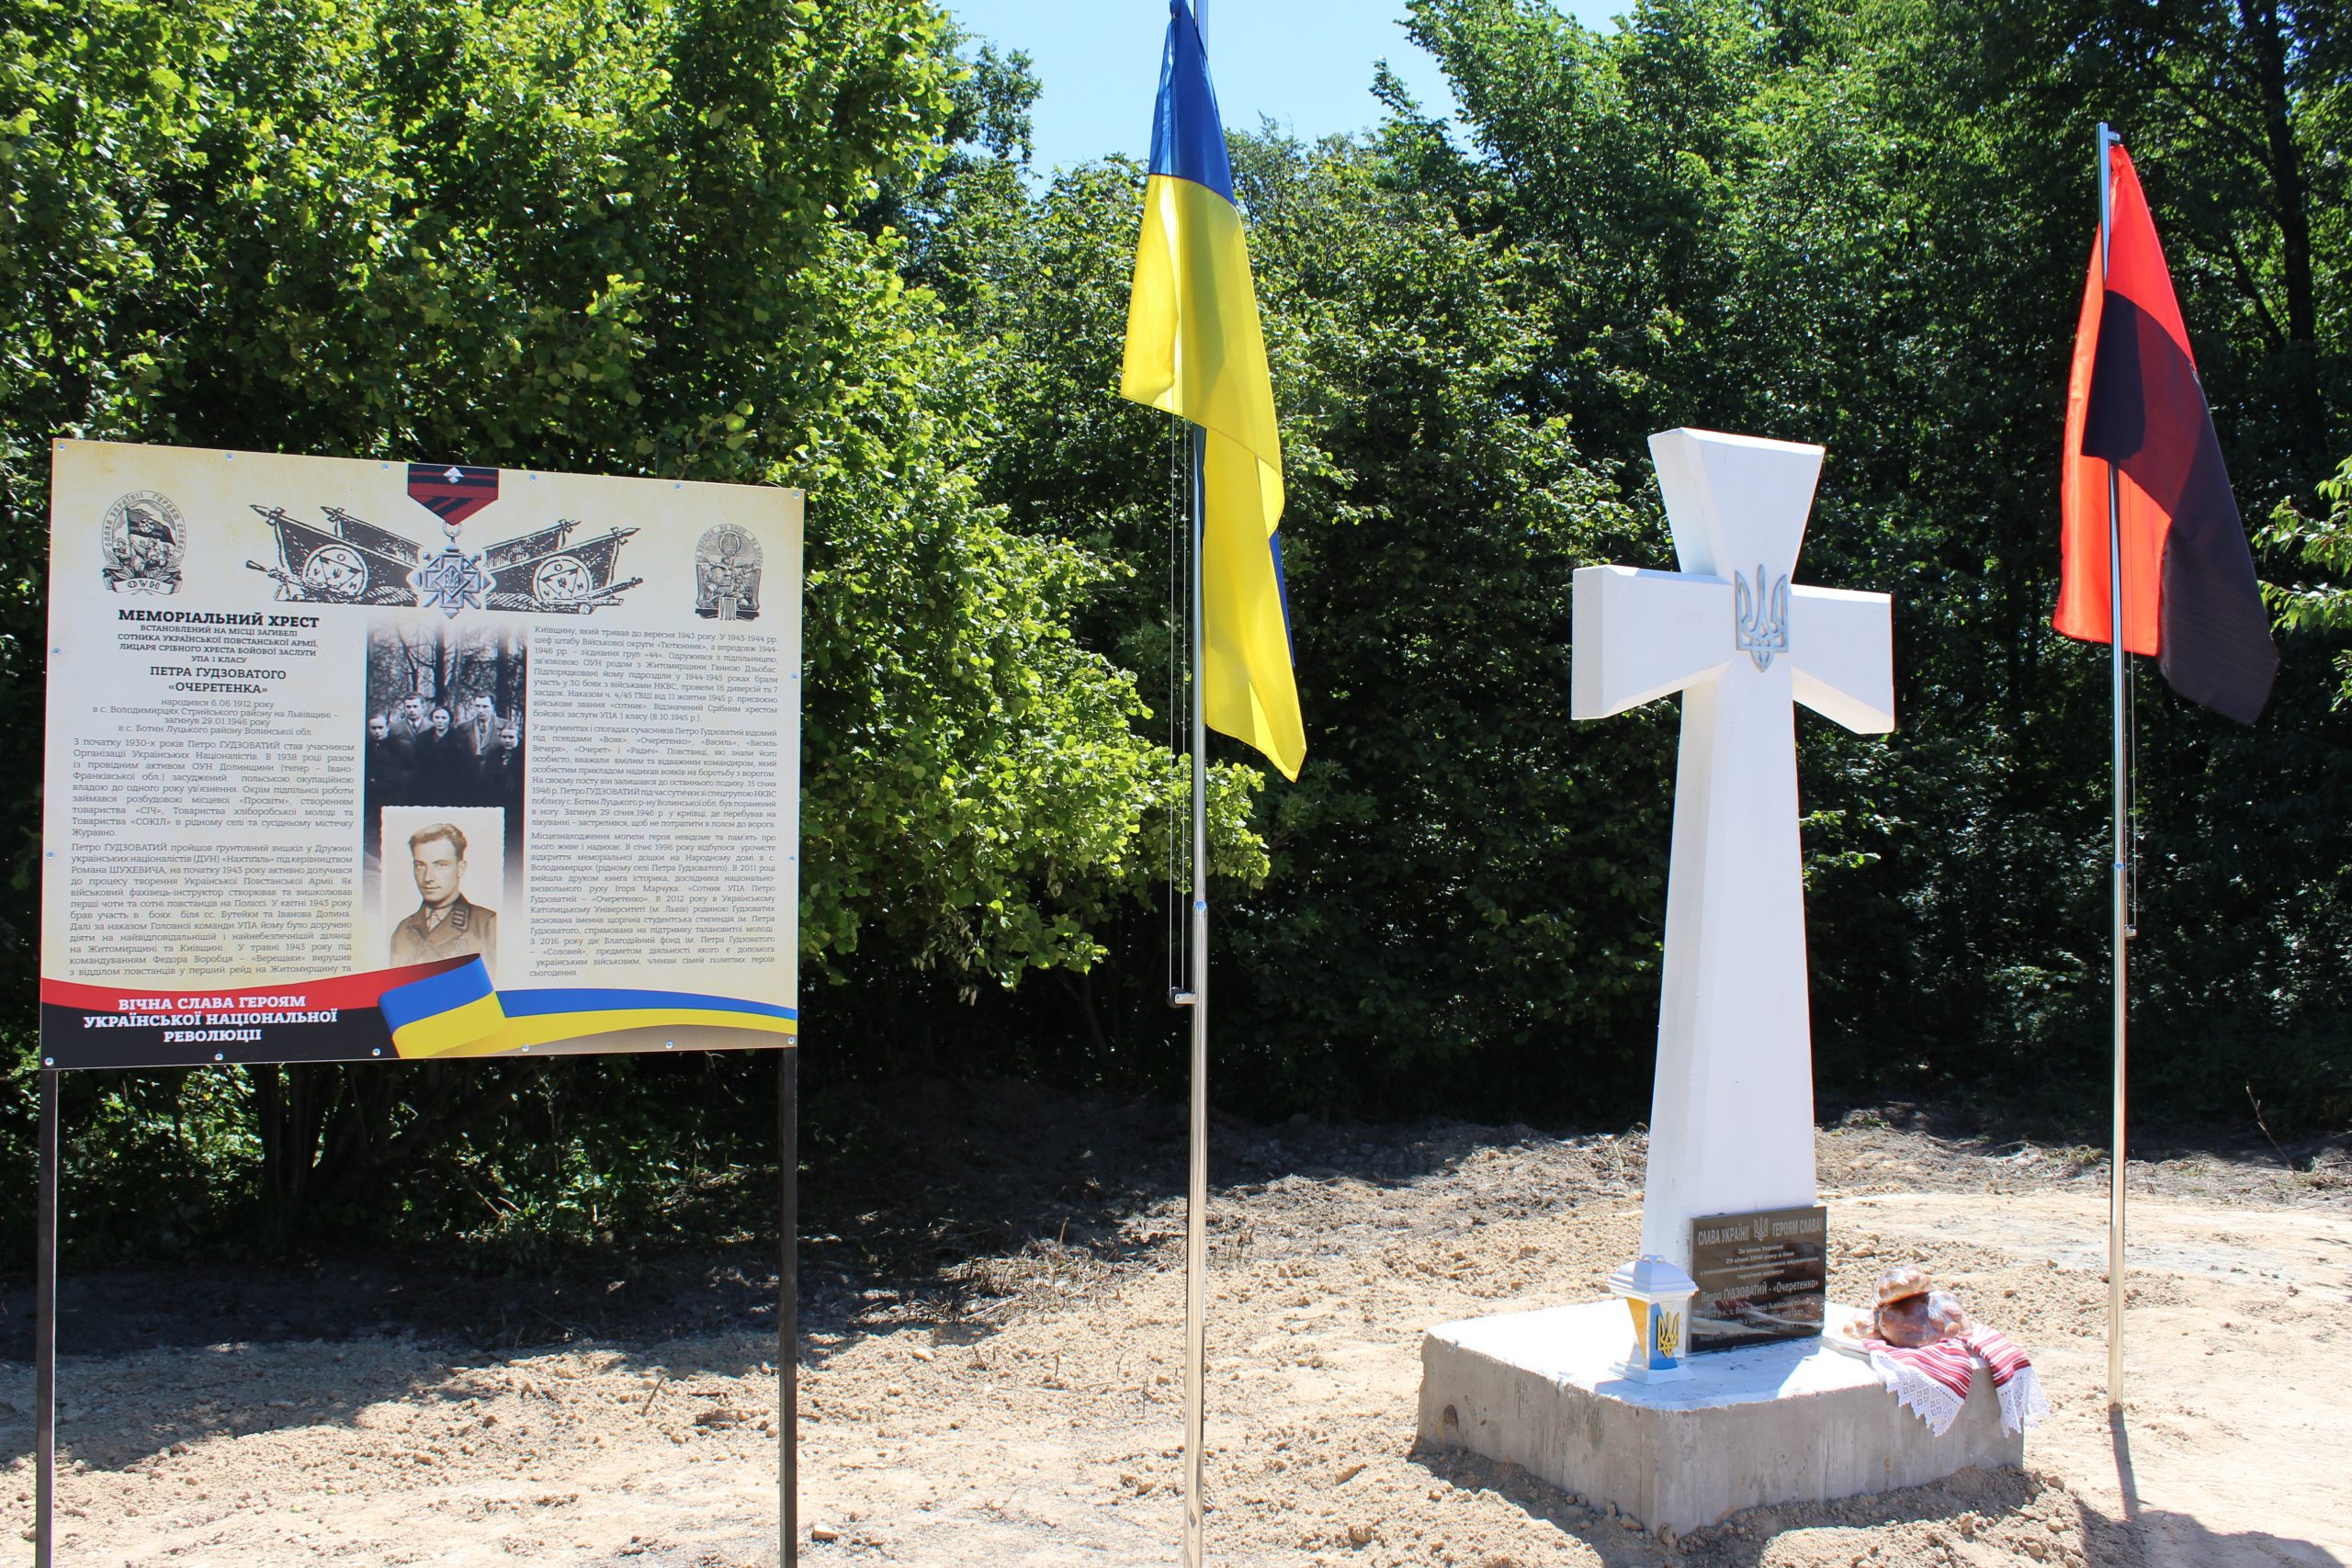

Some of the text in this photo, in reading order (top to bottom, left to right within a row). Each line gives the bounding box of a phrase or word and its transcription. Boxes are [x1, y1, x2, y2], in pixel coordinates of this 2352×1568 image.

[118, 608, 320, 627] МЕМОРІАЛЬНИЙ ХРЕСТ
[140, 625, 212, 635] ВСТАНОВЛЕНИЙ
[228, 628, 255, 637] МІСЦІ
[255, 629, 298, 637] ЗАГИБЕЛІ
[118, 633, 160, 642] СОТНИКА
[163, 633, 220, 644] УКРАЇНСЬКОЇ
[223, 635, 288, 646] ПОВСТАНСЬКОЇ
[119, 643, 156, 652] ЛИЦАРЯ
[158, 645, 201, 653] СРІБНОГО
[203, 646, 235, 654] ХРЕСТА
[237, 645, 277, 655] БОЙОВОЇ
[150, 665, 287, 681] ПЕТРА ҐУДЗОВАТОГО
[160, 698, 275, 710] народився 6.06.1912 року
[109, 705, 180, 716] Володимирцях
[179, 706, 239, 718] Стрийського
[238, 707, 273, 718] району
[286, 709, 332, 720] Львівщині
[164, 718, 200, 727] загинув
[248, 719, 271, 728] року
[135, 724, 164, 732] Ботин
[165, 725, 209, 736] Луцького
[209, 726, 243, 736] району
[243, 726, 294, 735] Волинської
[83, 740, 121, 749] початку
[125, 739, 156, 748] 1930-х
[159, 739, 184, 750] років
[187, 740, 216, 750] Петро
[306, 744, 355, 752] учасником
[73, 749, 127, 760] Організації
[131, 750, 190, 761] Українських
[277, 752, 298, 761] 1938
[302, 752, 322, 763] році
[326, 755, 355, 763] разом
[86, 761, 140, 772] провідним
[189, 761, 213, 771] ОУН
[218, 762, 274, 773] Долинщини
[323, 764, 355, 773] Івано-
[72, 772, 136, 783] Франківської
[141, 773, 164, 783] обл.)
[171, 773, 228, 784] засуджений
[295, 774, 355, 784] окупаційною
[72, 785, 108, 794] владою
[162, 786, 186, 795] року
[242, 784, 271, 795] Окрім
[273, 785, 320, 795] підпільної
[321, 785, 354, 796] роботи
[72, 795, 118, 803] займався
[125, 795, 183, 806] розбудовою
[190, 795, 231, 806] місцевої
[300, 798, 354, 807] створенням
[71, 807, 127, 816] товариства
[172, 807, 228, 817] Товариства
[232, 807, 298, 818] хліборобської
[301, 807, 336, 818] молоді
[73, 817, 127, 828] Товариства
[184, 818, 224, 828] рідному
[226, 818, 244, 826] селі
[258, 818, 312, 829] сусідньому
[314, 818, 355, 829] містечку
[118, 996, 306, 1010] ВІЧНА СЛАВА ГЕРОЯМ
[83, 1010, 337, 1028] УКРАЇНСЬКОЇ НАЦІОНАЛЬНОЇ
[1698, 1230, 1720, 1246] СЛАВА
[1772, 1220, 1798, 1237] ГЕРОЯМ
[1800, 1217, 1823, 1234] СЛАВА!
[1702, 1292, 1723, 1303] Петро
